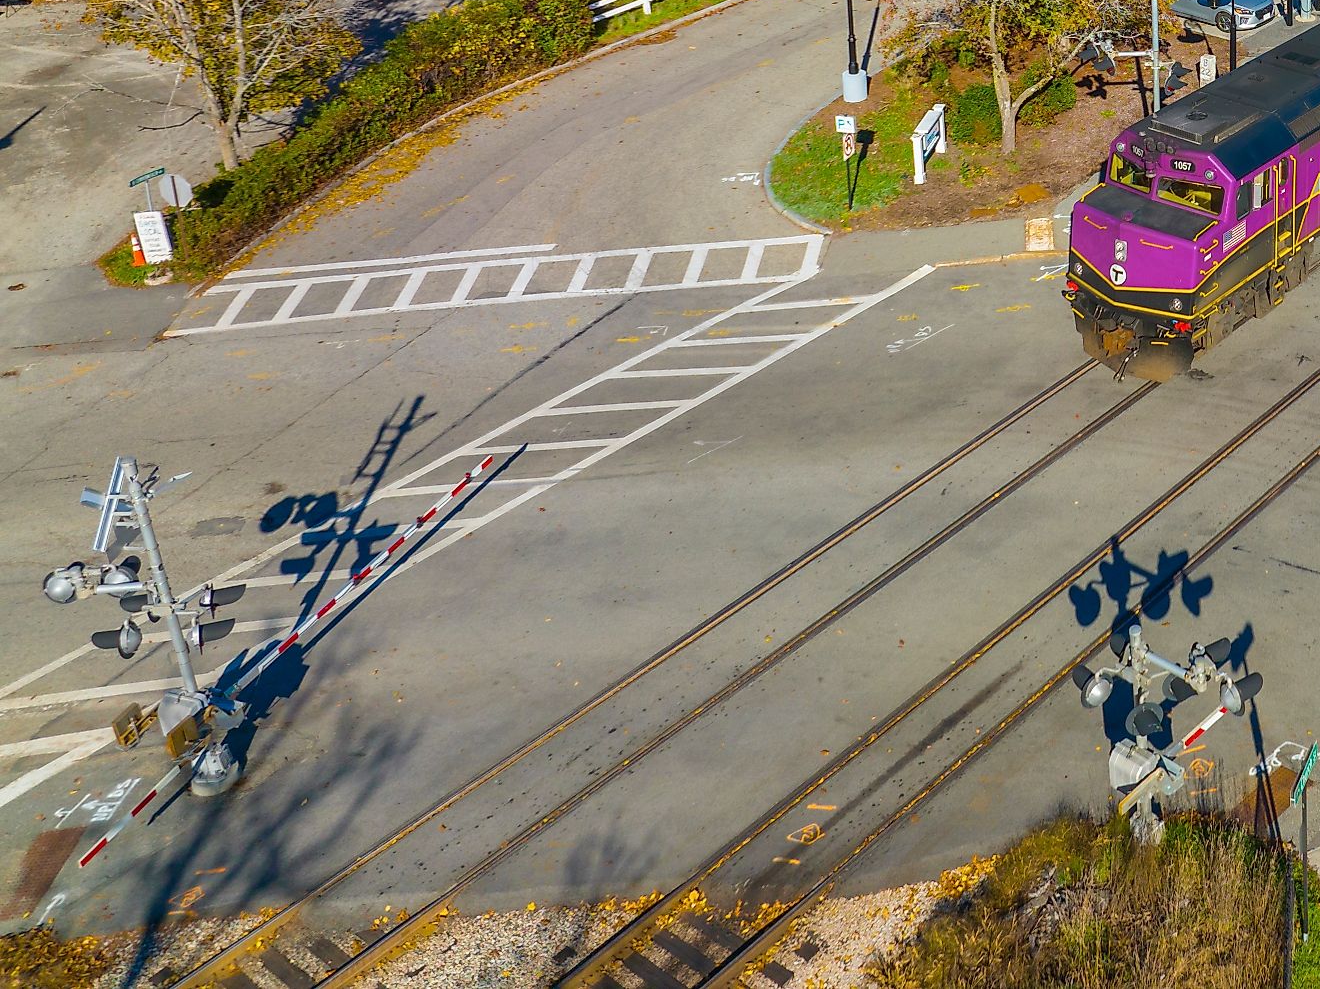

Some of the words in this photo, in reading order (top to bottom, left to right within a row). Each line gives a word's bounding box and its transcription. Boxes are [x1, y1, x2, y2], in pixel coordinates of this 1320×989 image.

[1132, 145, 1144, 158] 1057
[1173, 160, 1192, 171] 1057
[1112, 267, 1124, 282] T
